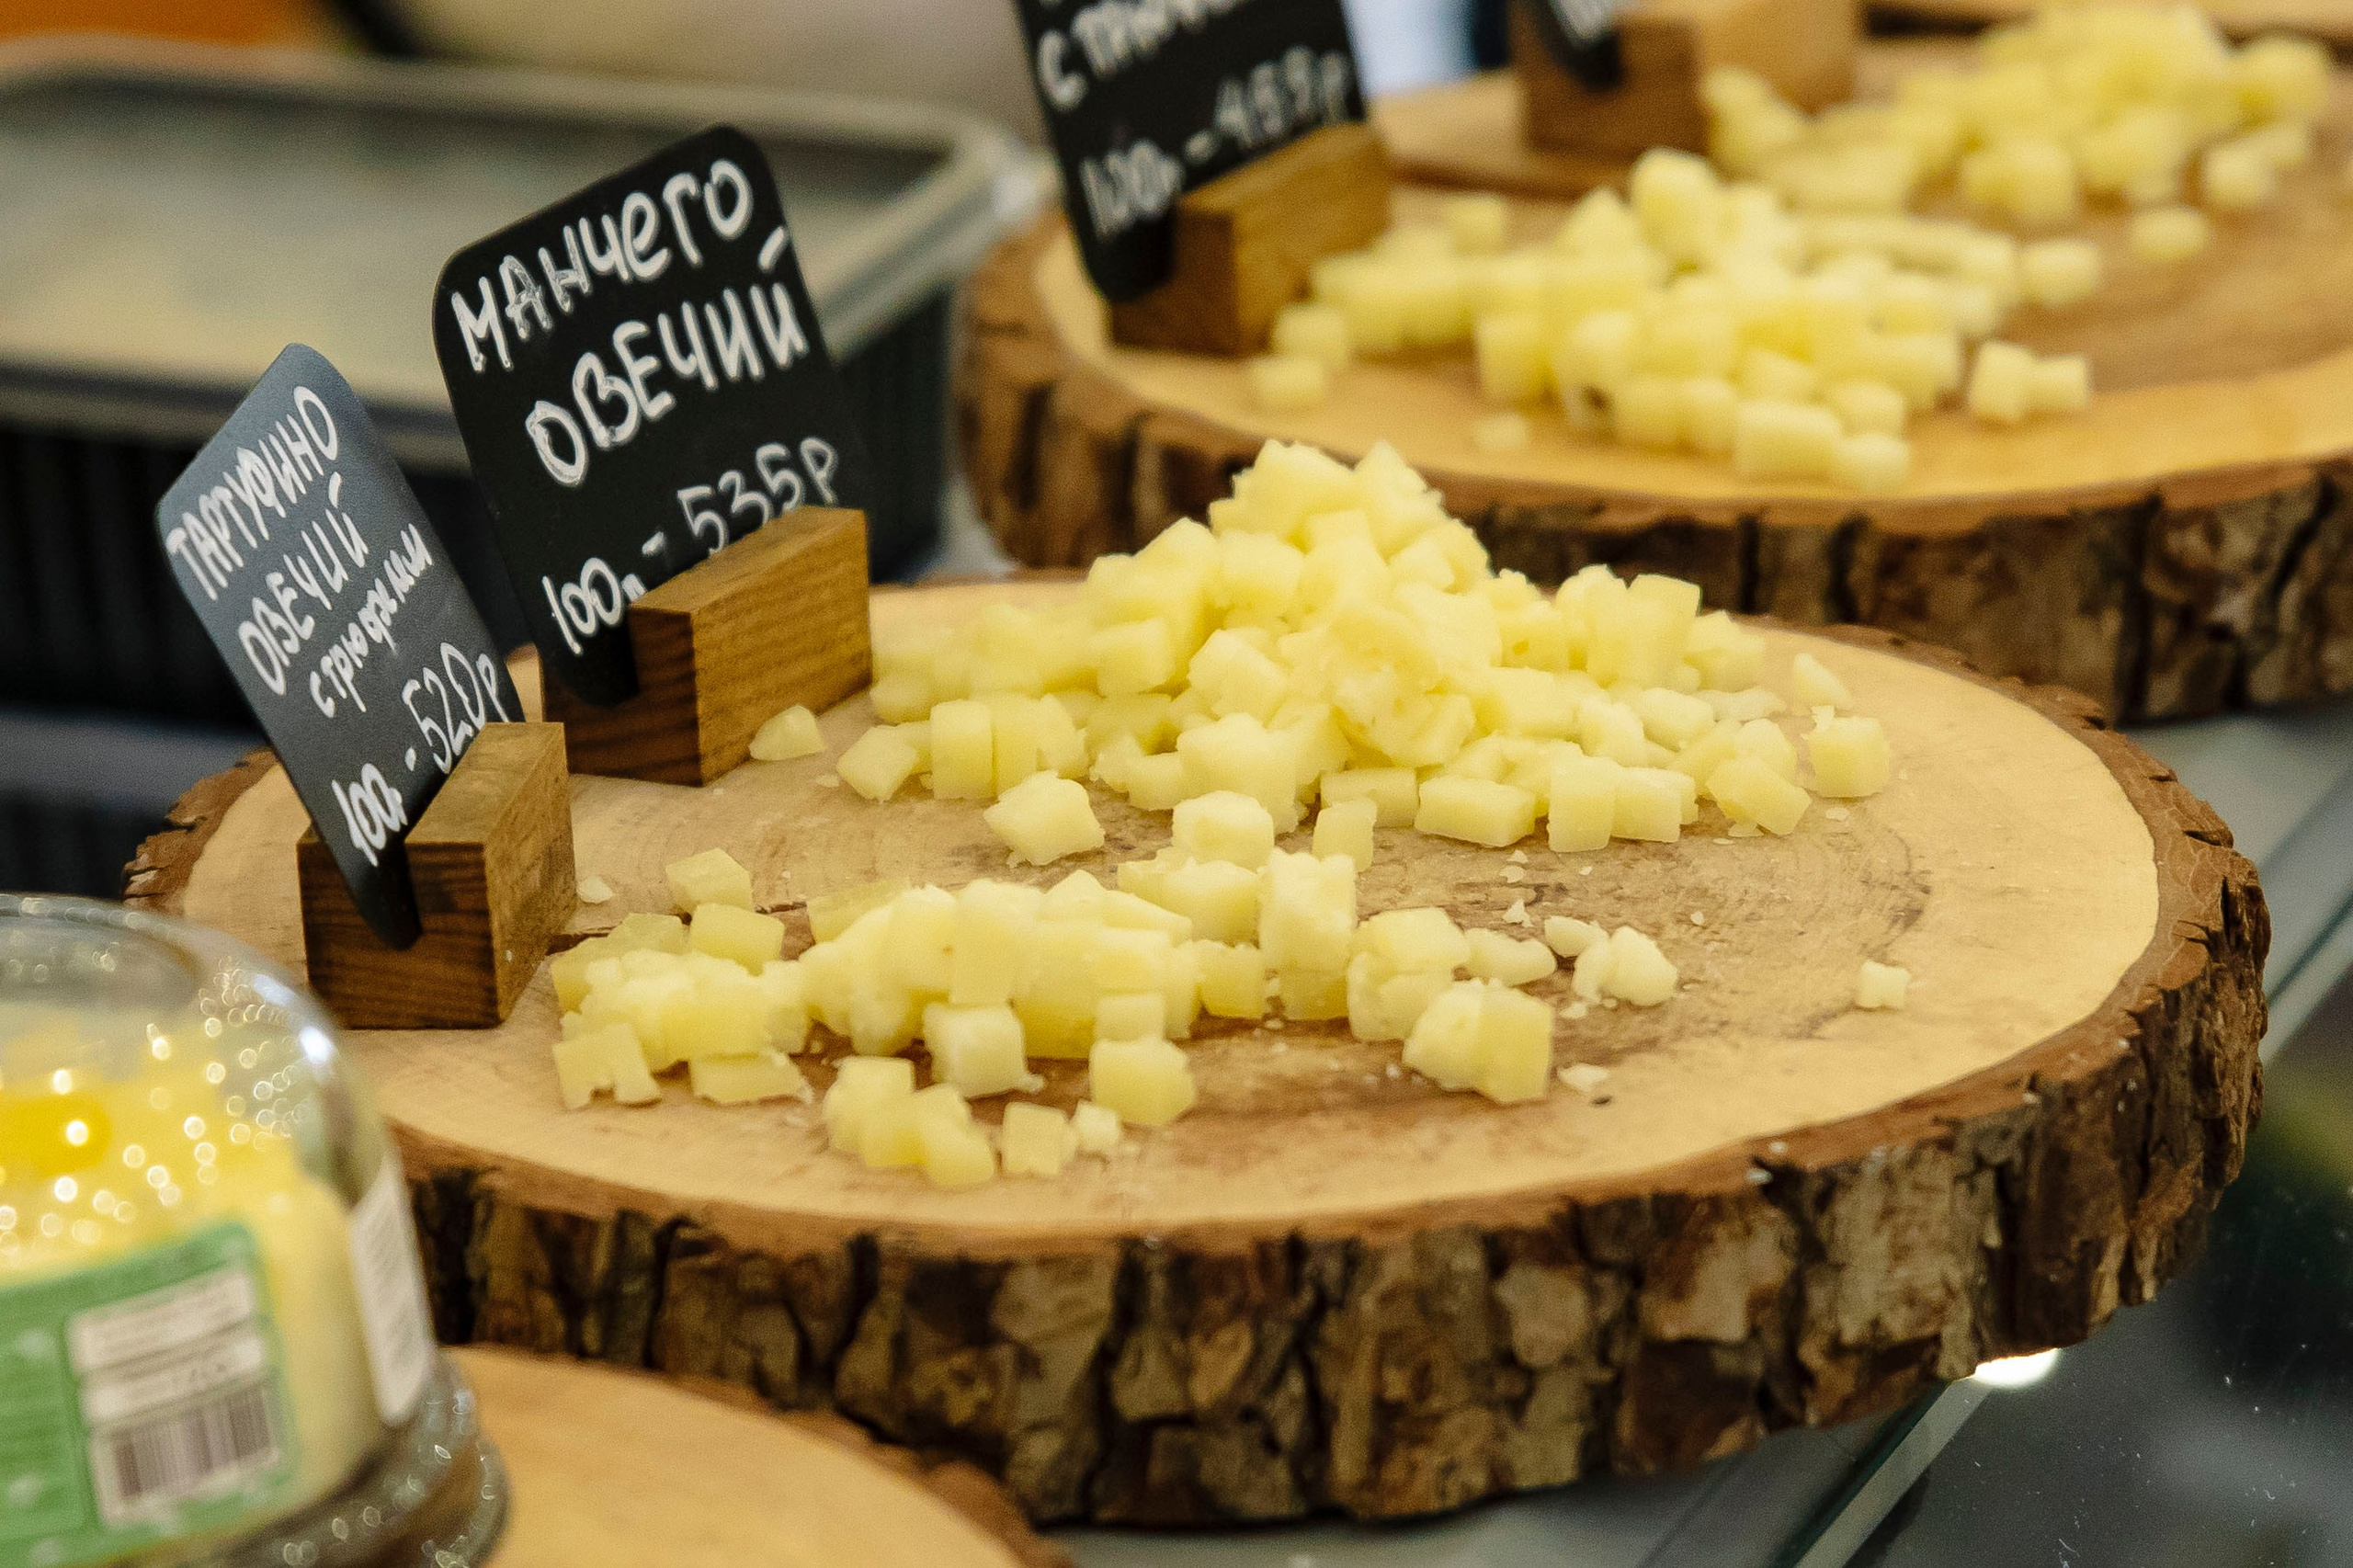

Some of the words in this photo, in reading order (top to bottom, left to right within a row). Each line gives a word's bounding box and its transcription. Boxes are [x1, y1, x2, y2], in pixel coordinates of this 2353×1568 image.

[525, 225, 811, 487] ОВЕЧИЙ
[165, 386, 338, 601] ТАРТУФИНО
[238, 472, 369, 696] ОВЕЧИЙ
